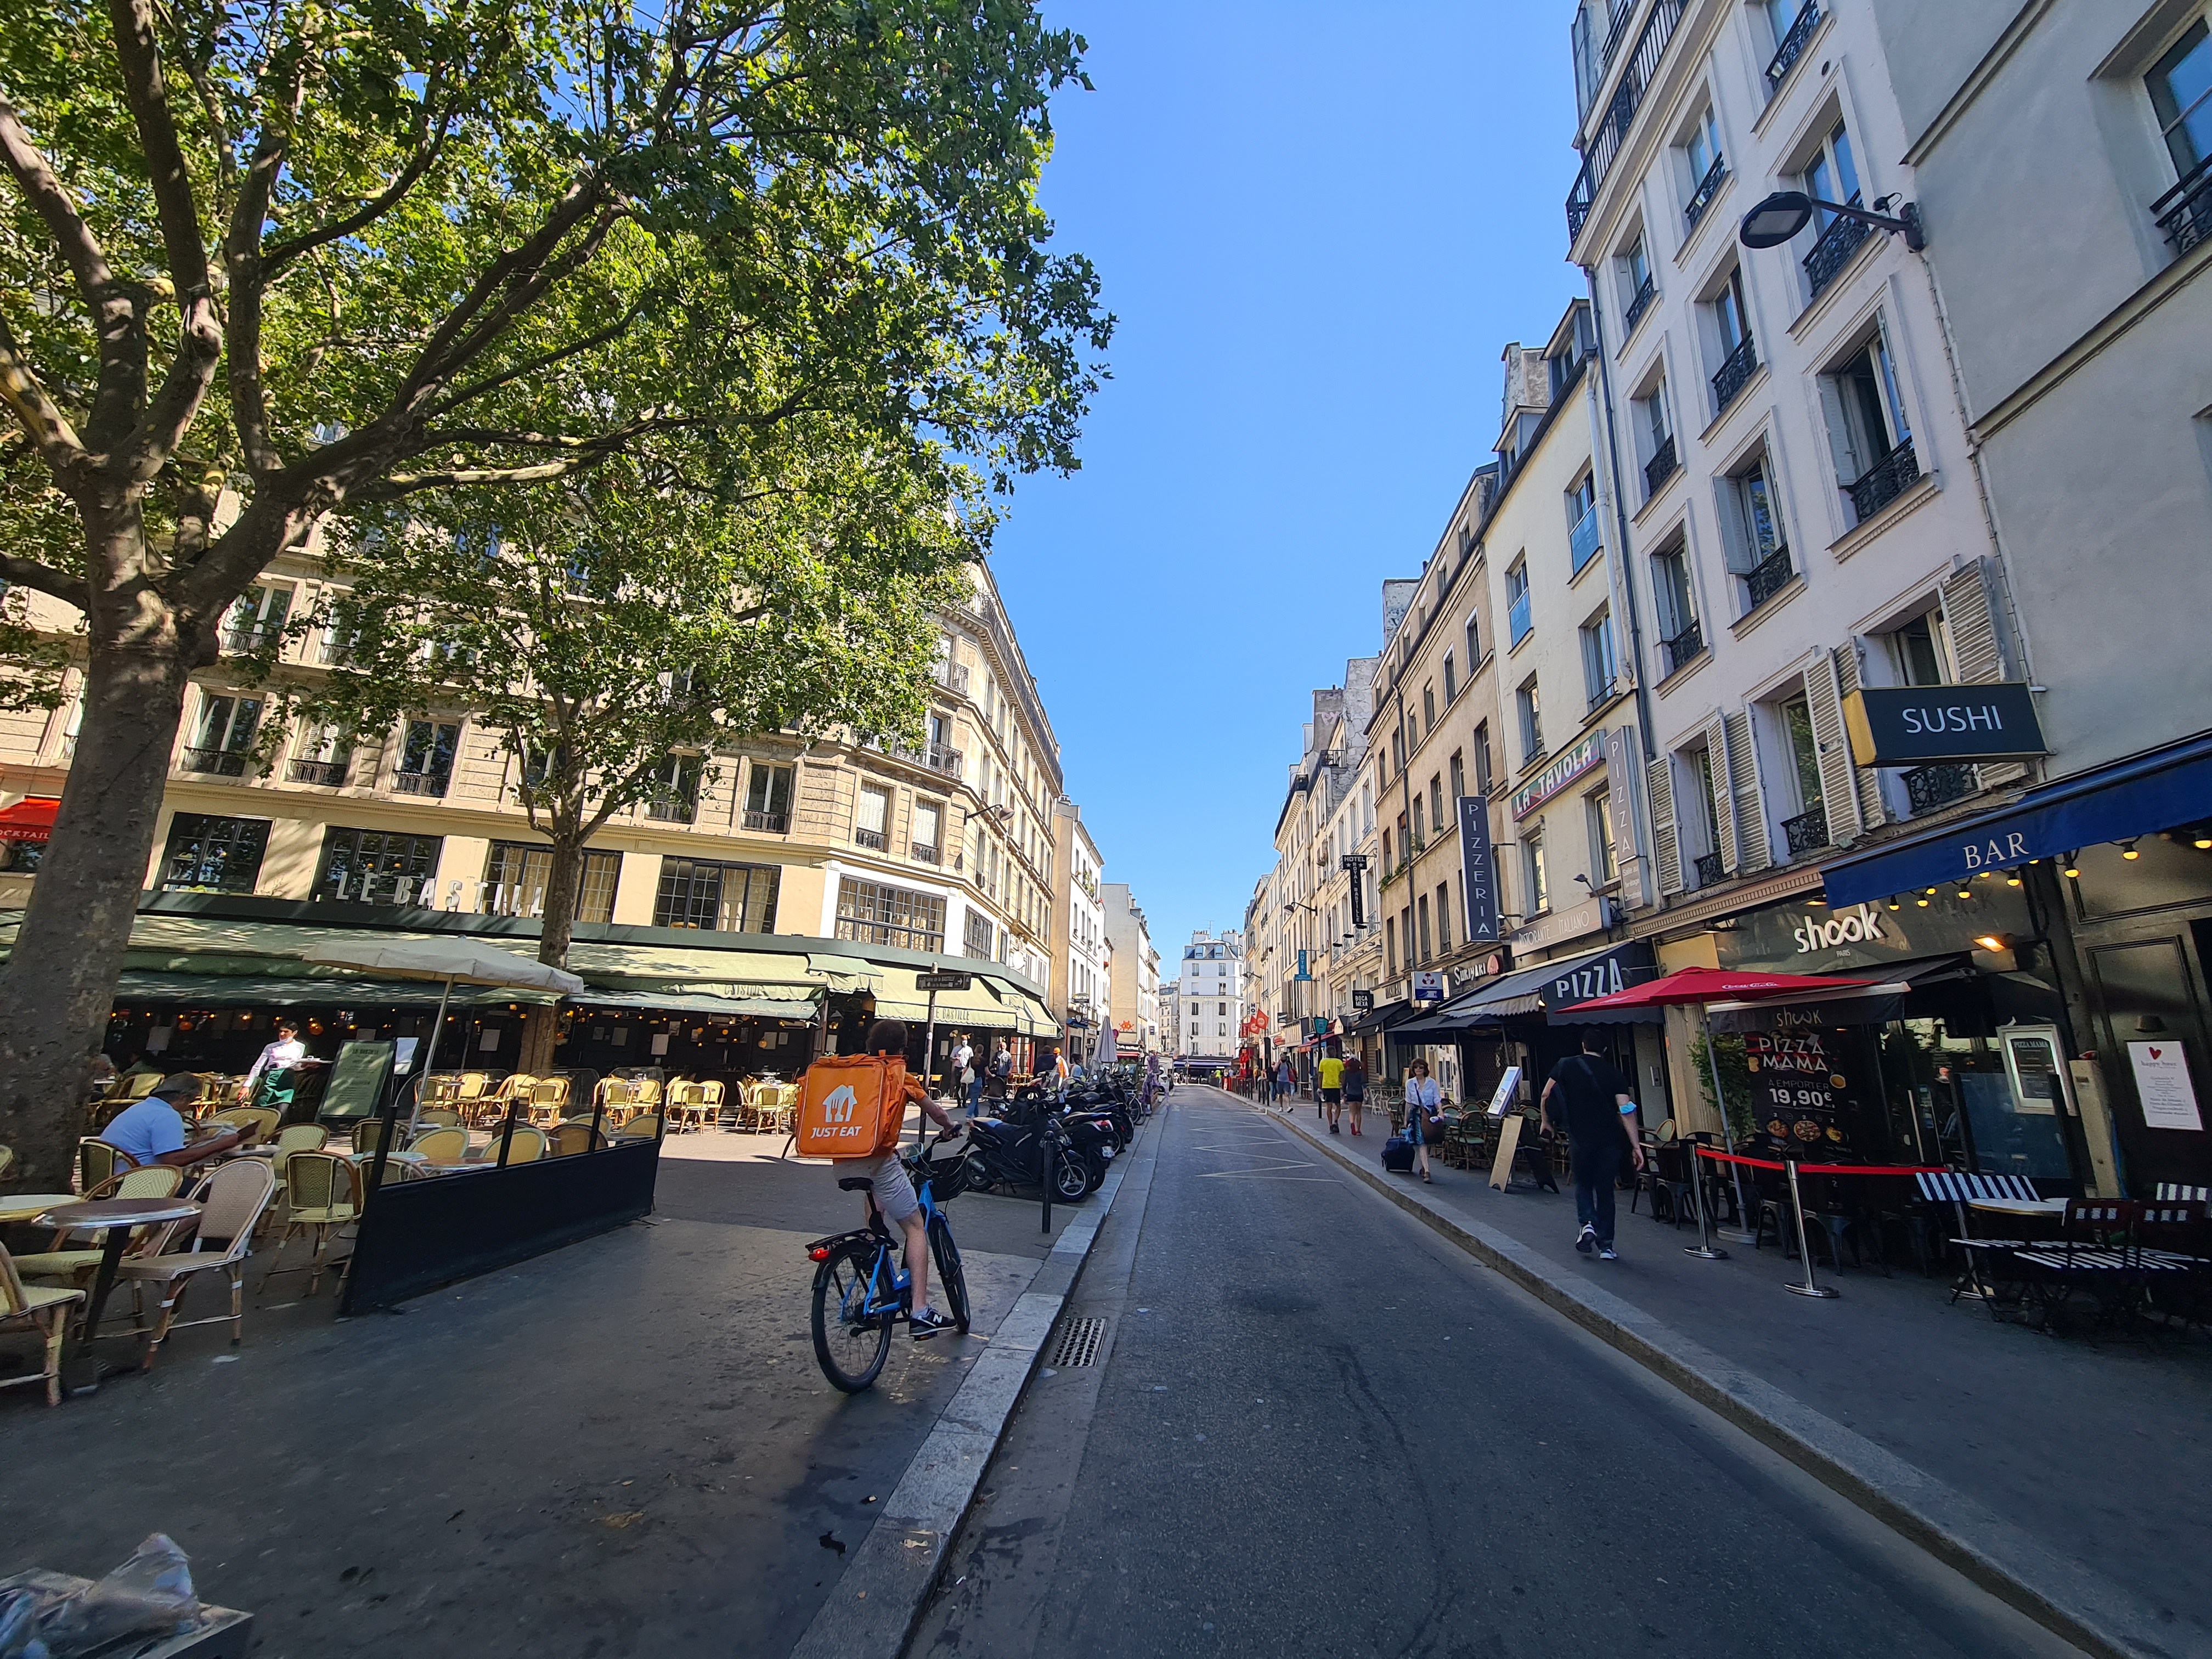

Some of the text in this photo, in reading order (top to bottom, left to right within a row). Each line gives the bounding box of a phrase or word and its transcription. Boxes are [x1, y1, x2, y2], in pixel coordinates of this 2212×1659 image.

[1902, 706, 2002, 733] SUSHI
[1516, 740, 1592, 814] LA TAVOLA
[1611, 741, 1631, 853] PIZZA
[1962, 832, 2029, 869] BAR
[1468, 804, 1491, 934] PIZZERIA
[335, 871, 544, 915] LE BASTILL
[1518, 910, 1589, 947] RISTORANTE ITALIANO
[1794, 903, 1885, 953] shook
[1836, 949, 1852, 957] PARIS
[1556, 958, 1624, 998] PIZZA
[942, 1008, 970, 1020] BASTILLE
[1758, 1037, 1825, 1055] PIZZA
[1763, 1054, 1829, 1072] MAMA
[1769, 1088, 1832, 1107] 19,90€
[1776, 1079, 1830, 1091] EMPORTER
[810, 1126, 862, 1139] JUST EAT
[933, 1313, 943, 1324] N
